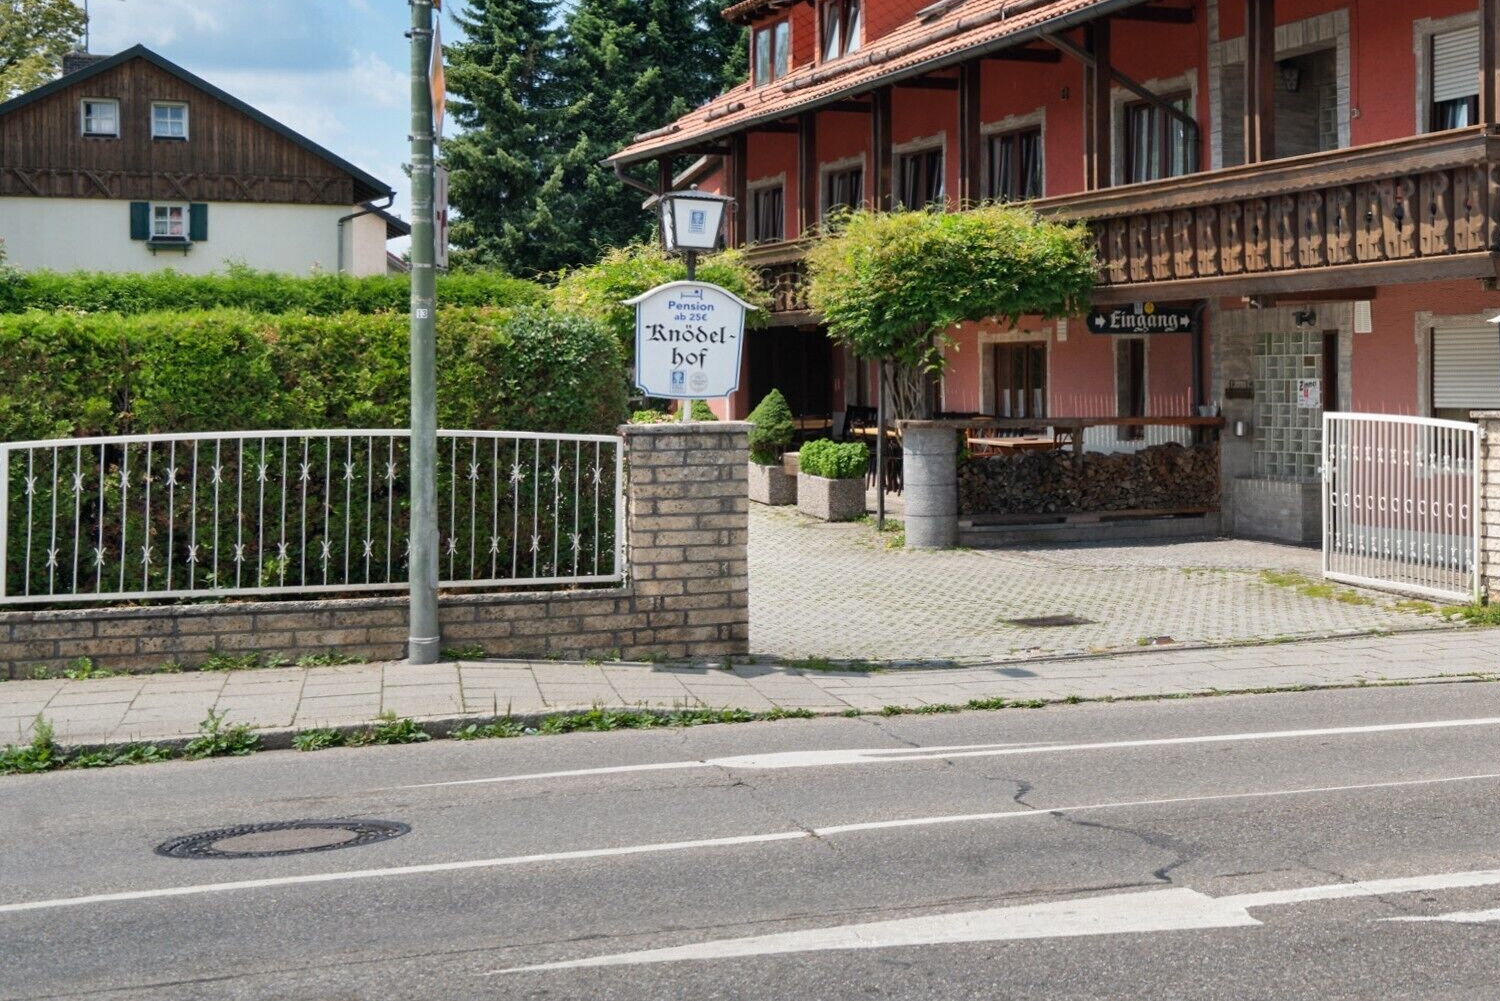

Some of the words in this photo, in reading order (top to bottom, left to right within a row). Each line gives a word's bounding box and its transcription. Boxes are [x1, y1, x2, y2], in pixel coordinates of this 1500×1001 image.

[668, 300, 715, 311] Pension
[674, 313, 687, 321] ab
[689, 313, 707, 321] 25€
[1109, 310, 1178, 332] Eingang
[645, 323, 736, 343] Knödel-
[670, 347, 709, 369] hof
